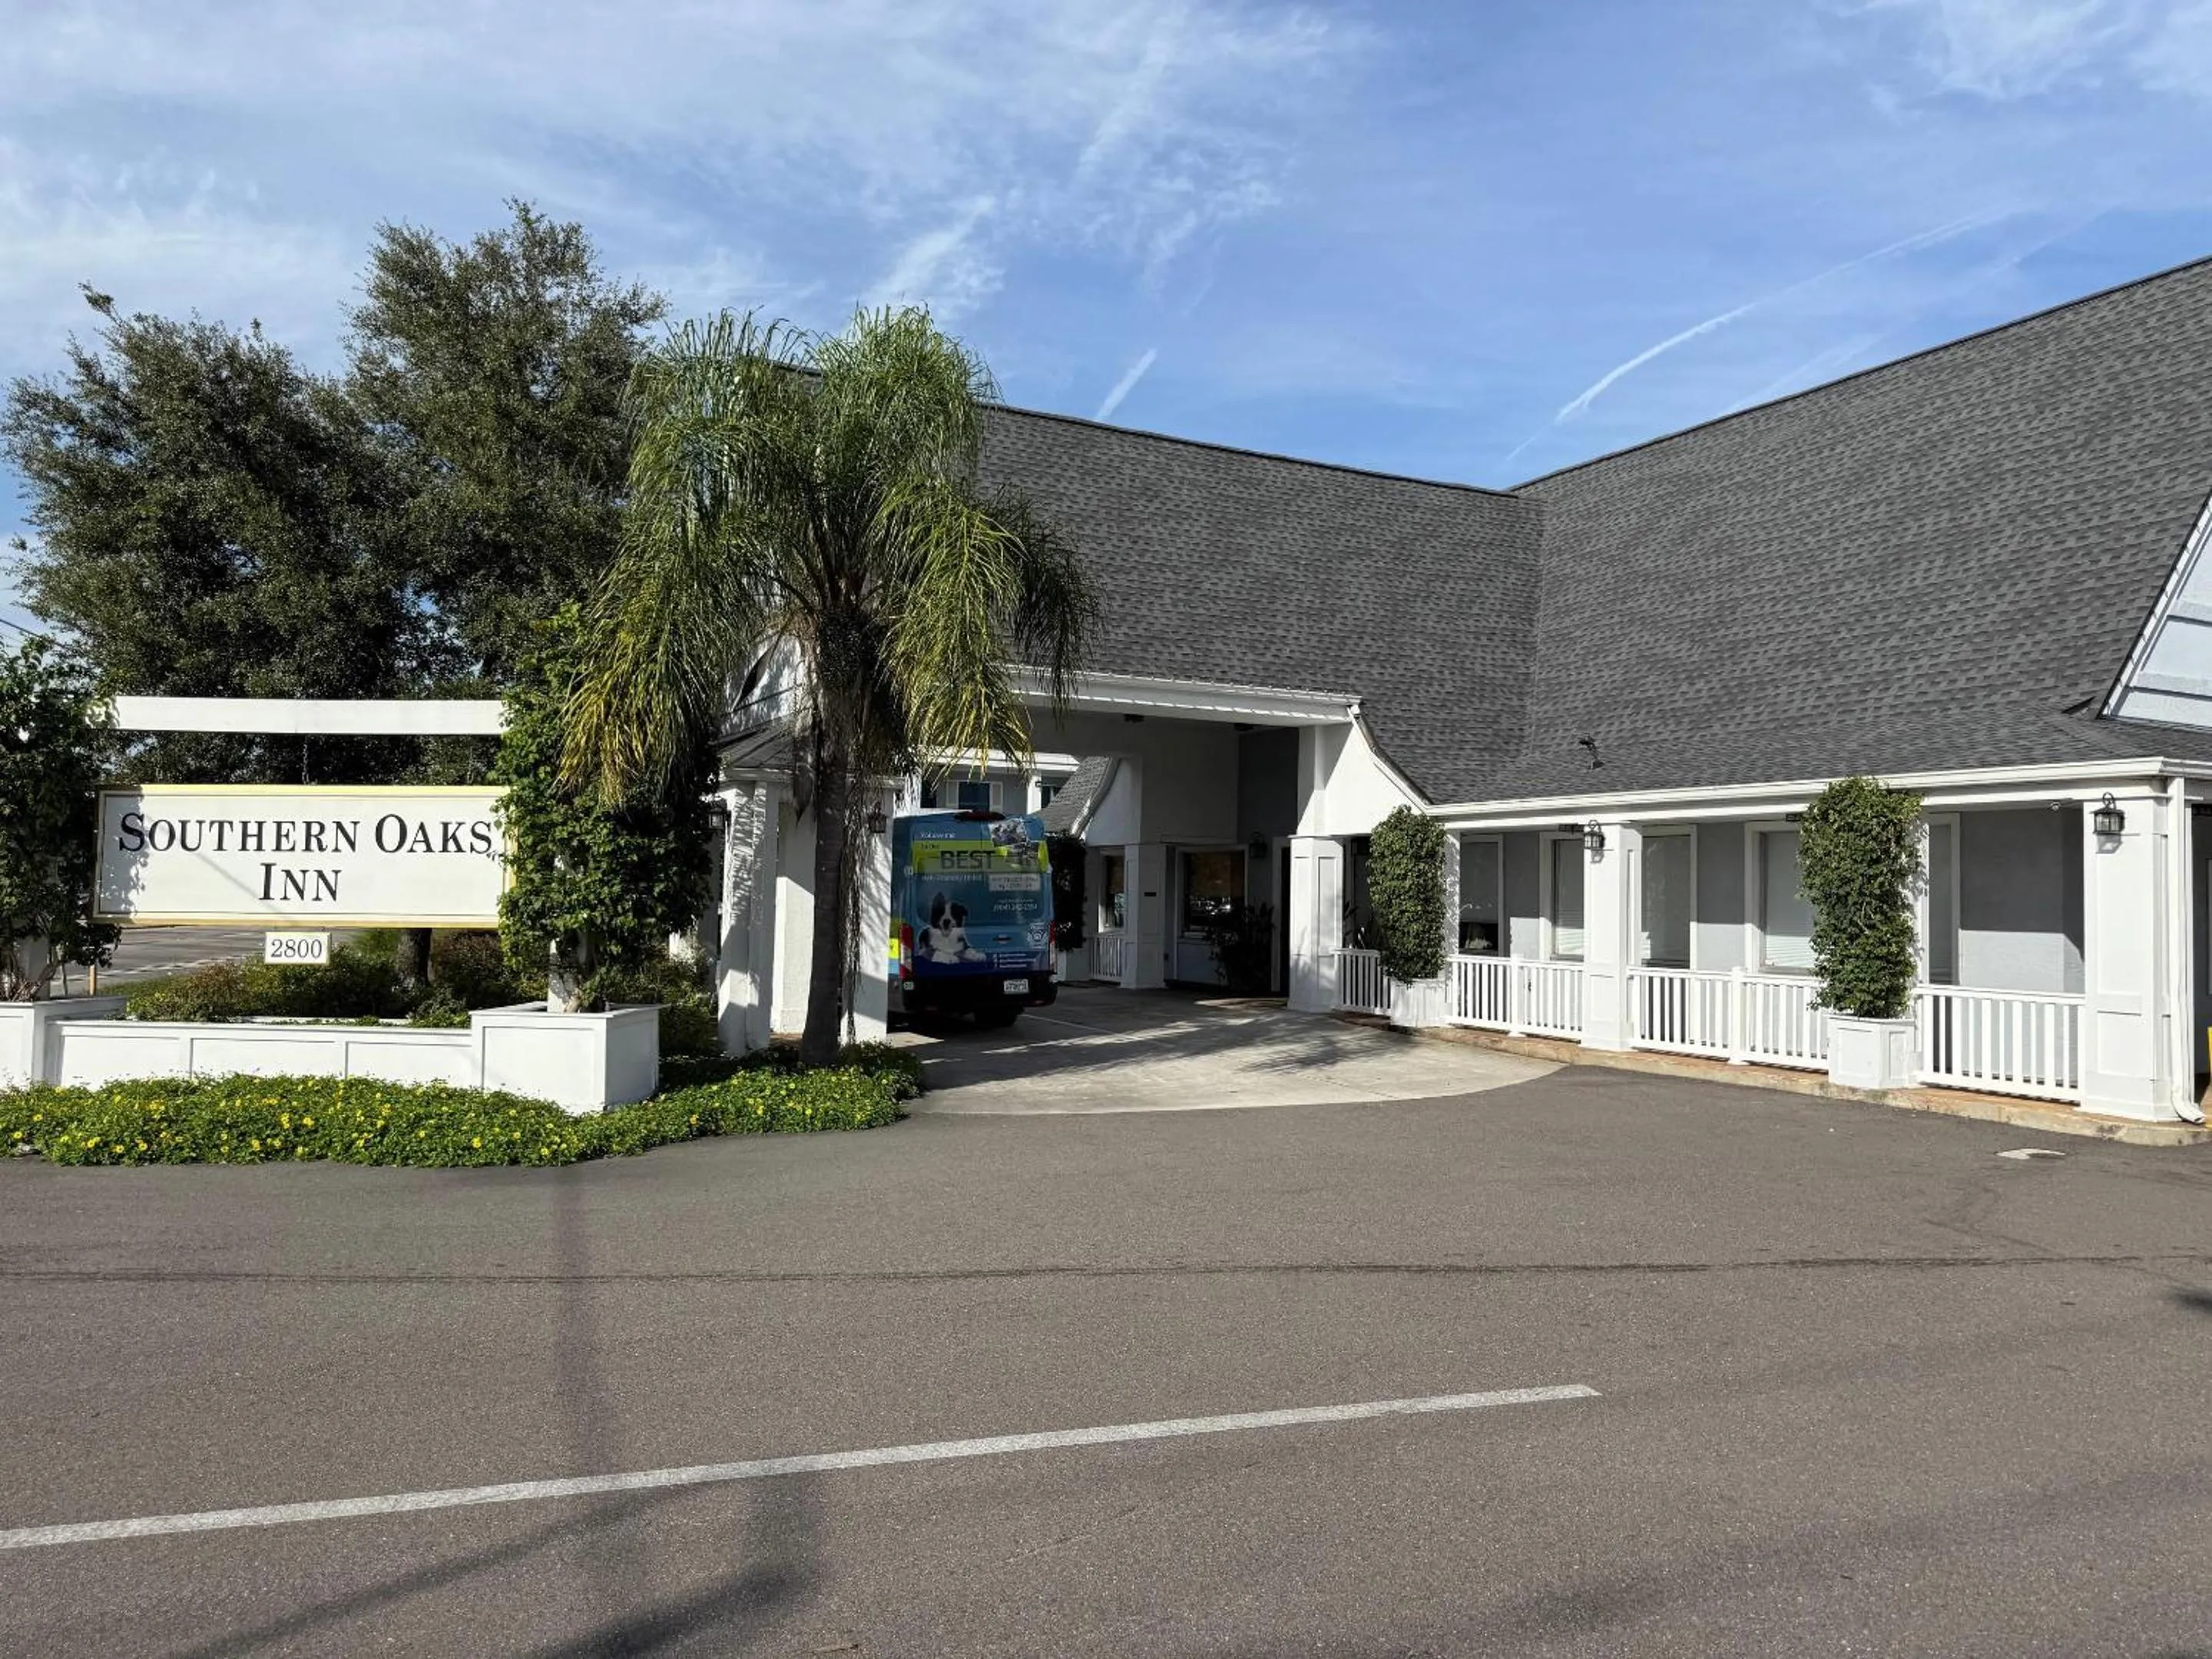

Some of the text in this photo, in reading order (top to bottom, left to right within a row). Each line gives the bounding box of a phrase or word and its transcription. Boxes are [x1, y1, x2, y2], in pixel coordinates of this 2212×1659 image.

[118, 812, 492, 855] SOUTHERN OAKS
[939, 849, 996, 869] BEST
[258, 862, 343, 902] INN
[270, 939, 323, 959] 2800
